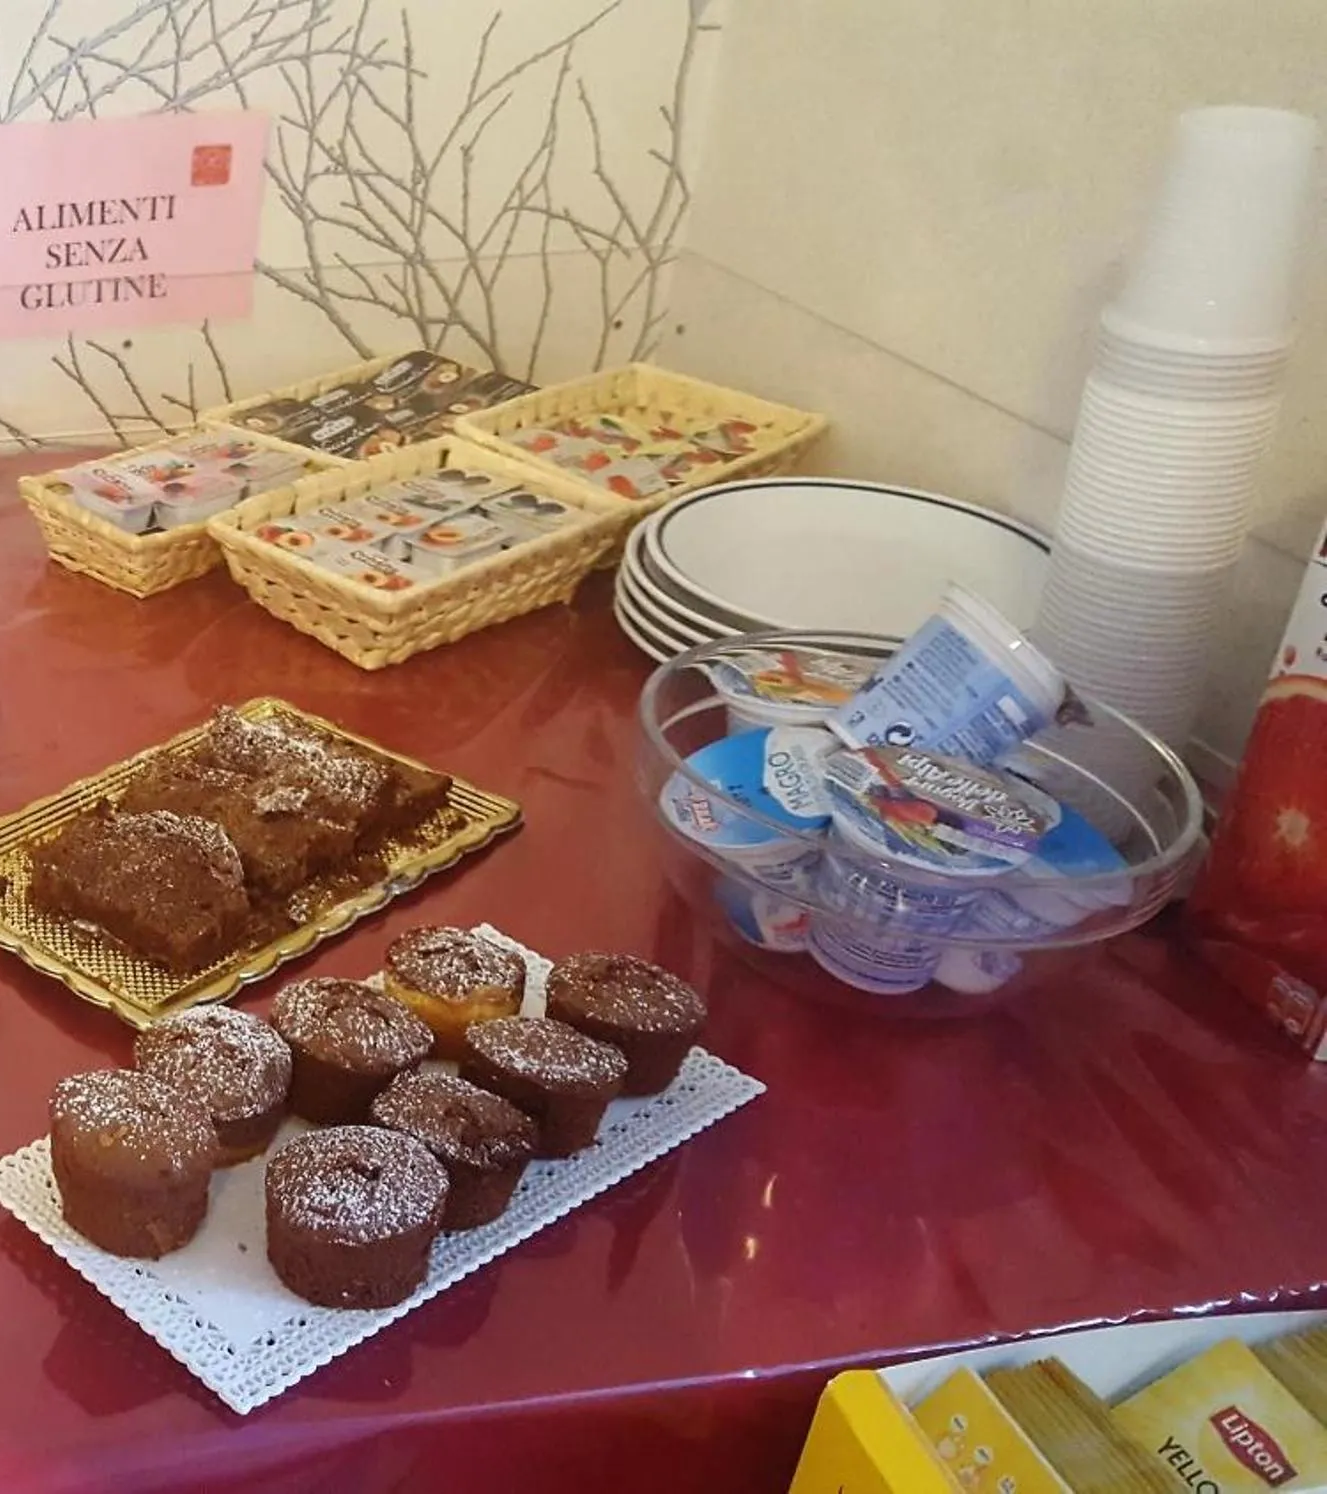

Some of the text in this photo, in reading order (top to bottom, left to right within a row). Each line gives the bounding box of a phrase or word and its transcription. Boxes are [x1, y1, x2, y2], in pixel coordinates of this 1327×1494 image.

[12, 194, 176, 233] ALIMENTI
[45, 237, 149, 269] SENZA
[20, 272, 168, 311] GLUTINE
[768, 752, 813, 810] MAGRO
[1221, 1413, 1286, 1480] Lipton
